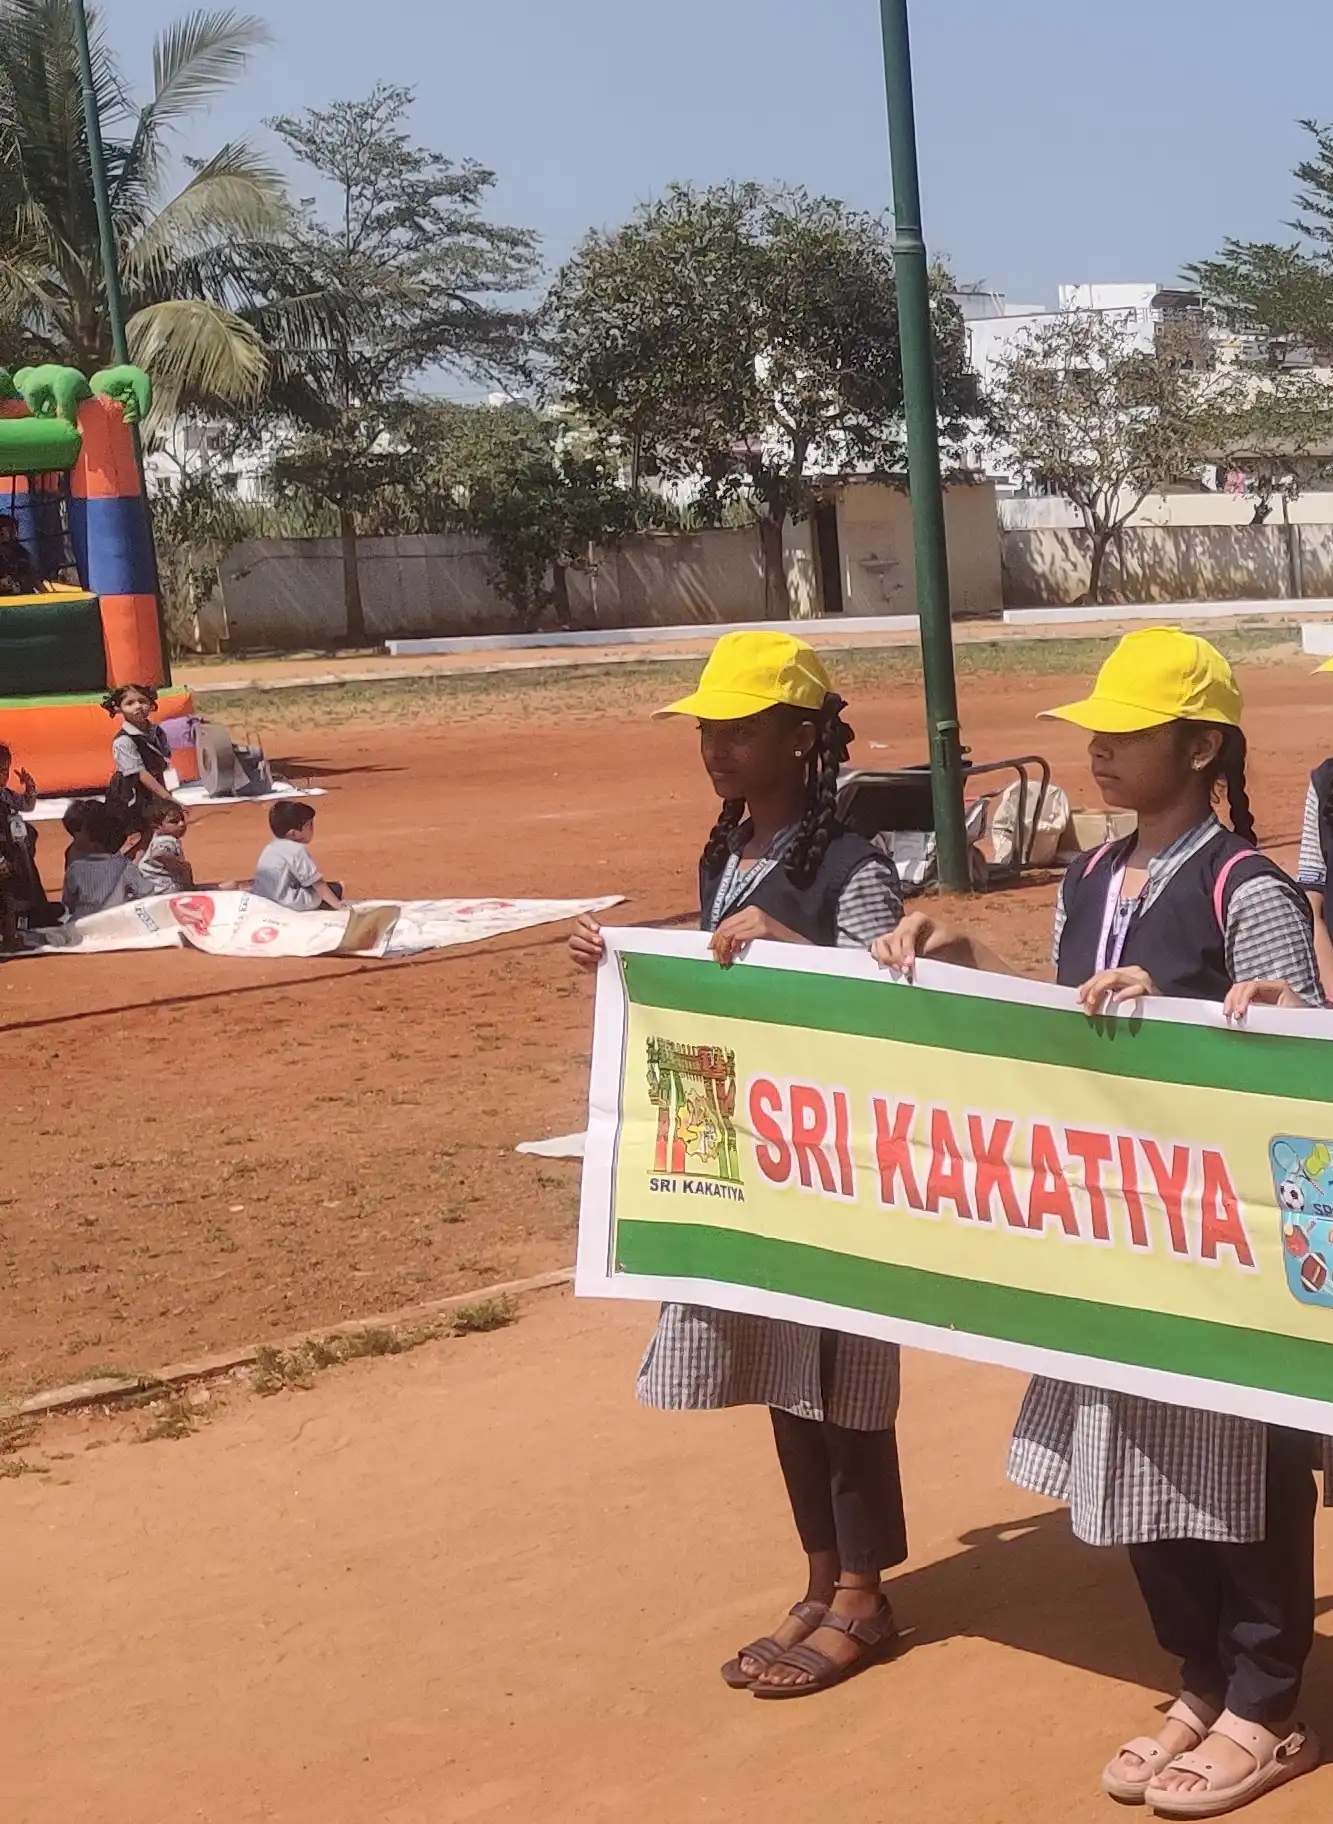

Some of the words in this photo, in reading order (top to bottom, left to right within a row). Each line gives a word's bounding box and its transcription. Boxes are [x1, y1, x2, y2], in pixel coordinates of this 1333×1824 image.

[649, 1177, 677, 1194] SRI
[682, 1179, 746, 1203] KAKATIYA
[747, 1076, 854, 1196] SRI
[872, 1097, 1256, 1268] KAKATIYA
